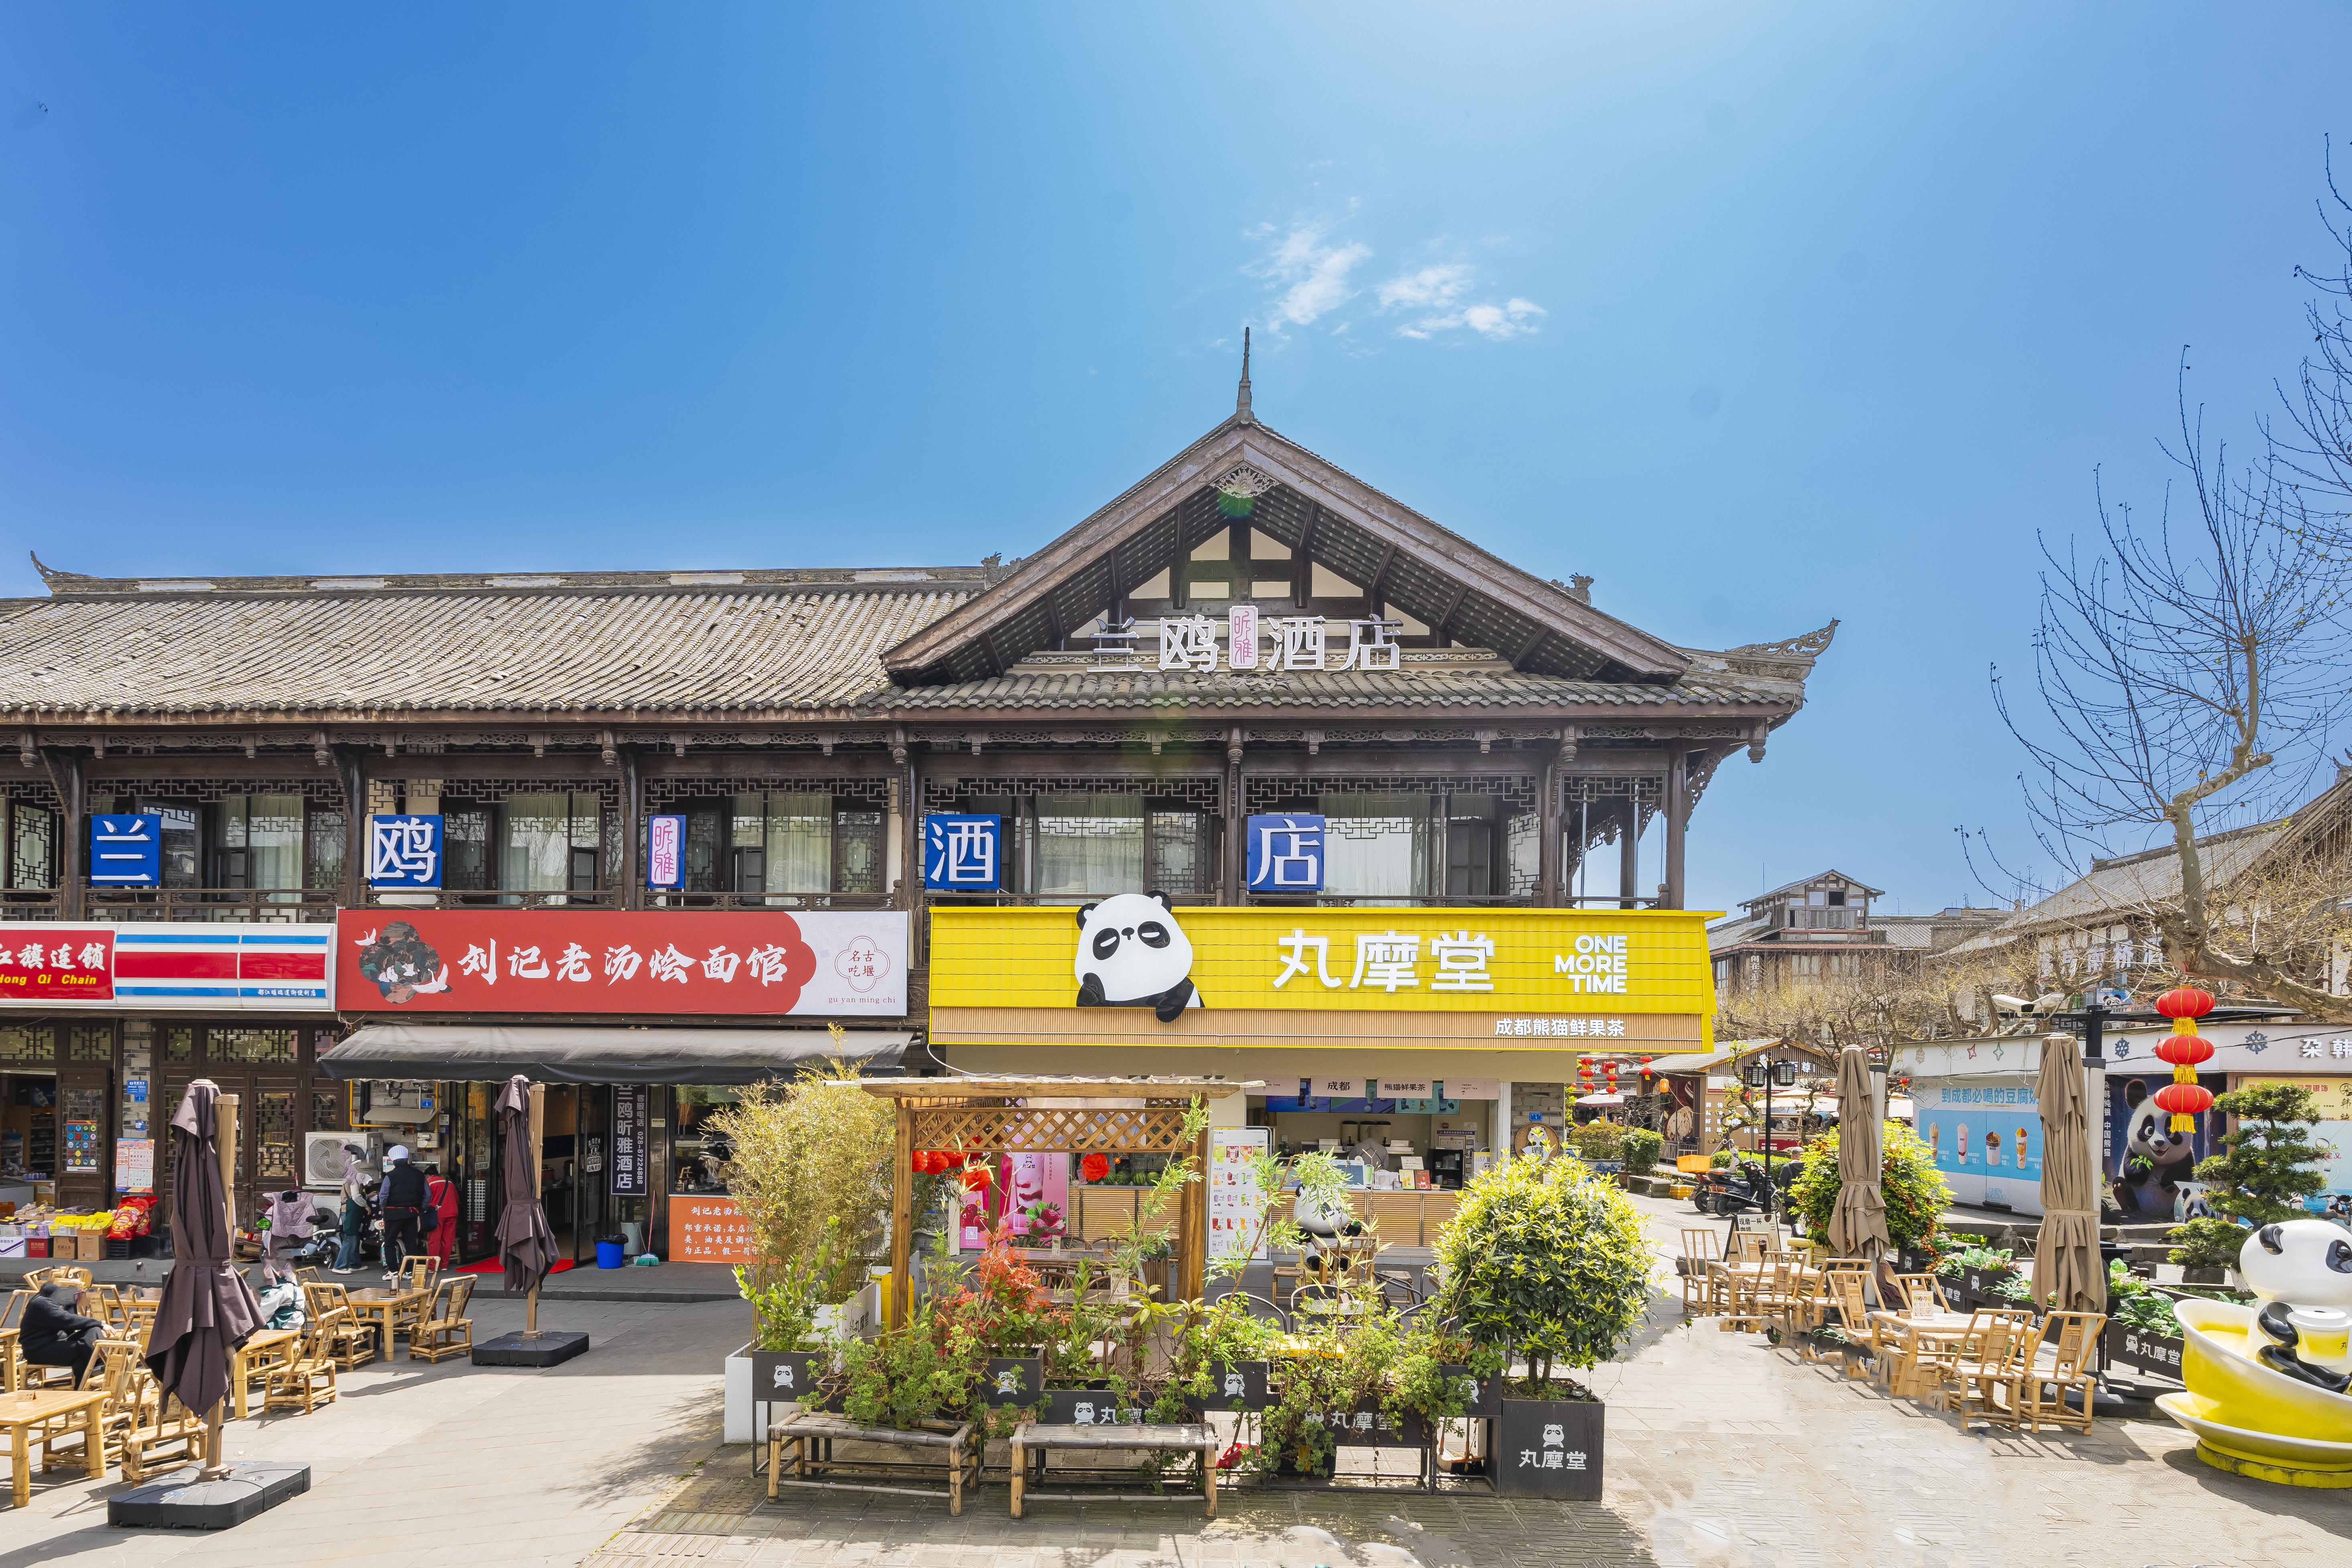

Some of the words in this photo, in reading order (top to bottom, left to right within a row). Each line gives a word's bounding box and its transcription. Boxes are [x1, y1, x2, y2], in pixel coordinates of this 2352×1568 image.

[92, 819, 153, 881] 兰
[371, 817, 437, 883] 鸥
[930, 820, 995, 882] 酒
[1250, 819, 1321, 886] 店
[1574, 935, 1628, 954] ONE
[458, 938, 788, 987] 刘记老汤烩面馆
[1272, 929, 1495, 993] 丸摩堂
[1554, 955, 1628, 974] MORE
[37, 974, 52, 984] Qi
[61, 974, 97, 984] Chain
[1568, 974, 1628, 994] TIME
[1495, 1017, 1625, 1037] 成都熊猫鲜果茶
[1327, 1081, 1350, 1091] 成都
[2140, 1342, 2181, 1366] 丸摩堂
[1519, 1449, 1587, 1470] 丸摩堂
